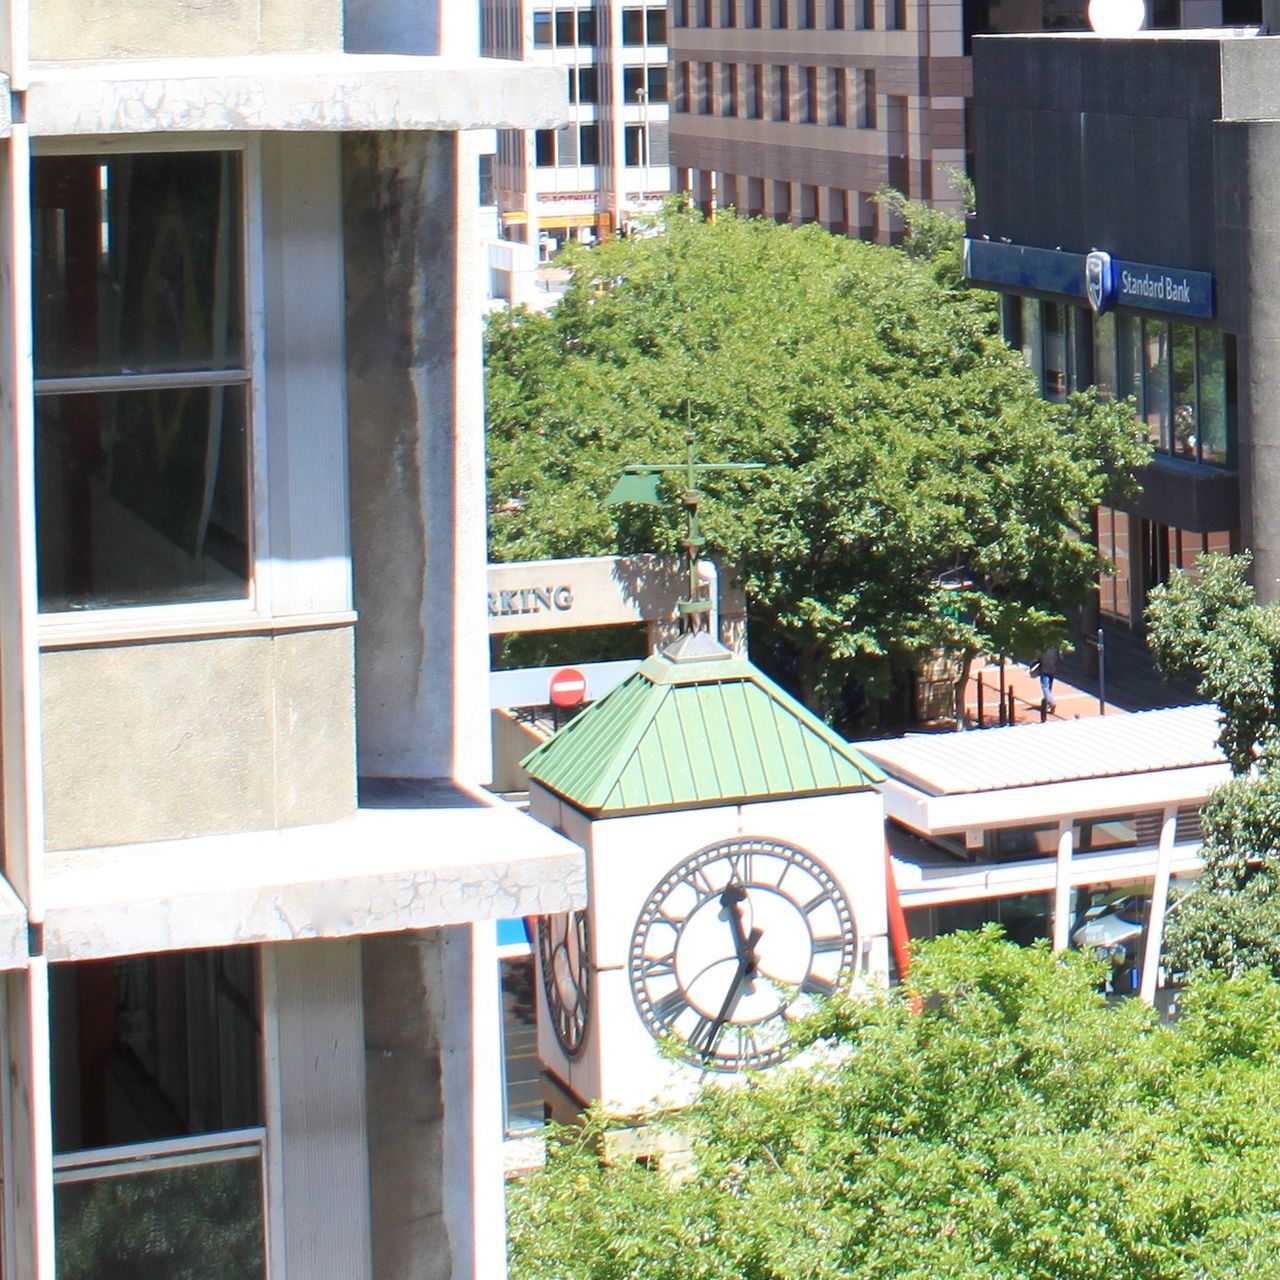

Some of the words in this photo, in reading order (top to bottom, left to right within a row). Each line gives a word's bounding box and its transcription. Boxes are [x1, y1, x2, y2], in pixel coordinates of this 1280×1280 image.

[1122, 270, 1164, 299] Standard
[1165, 277, 1190, 303] Bank
[487, 585, 573, 617] RKING
